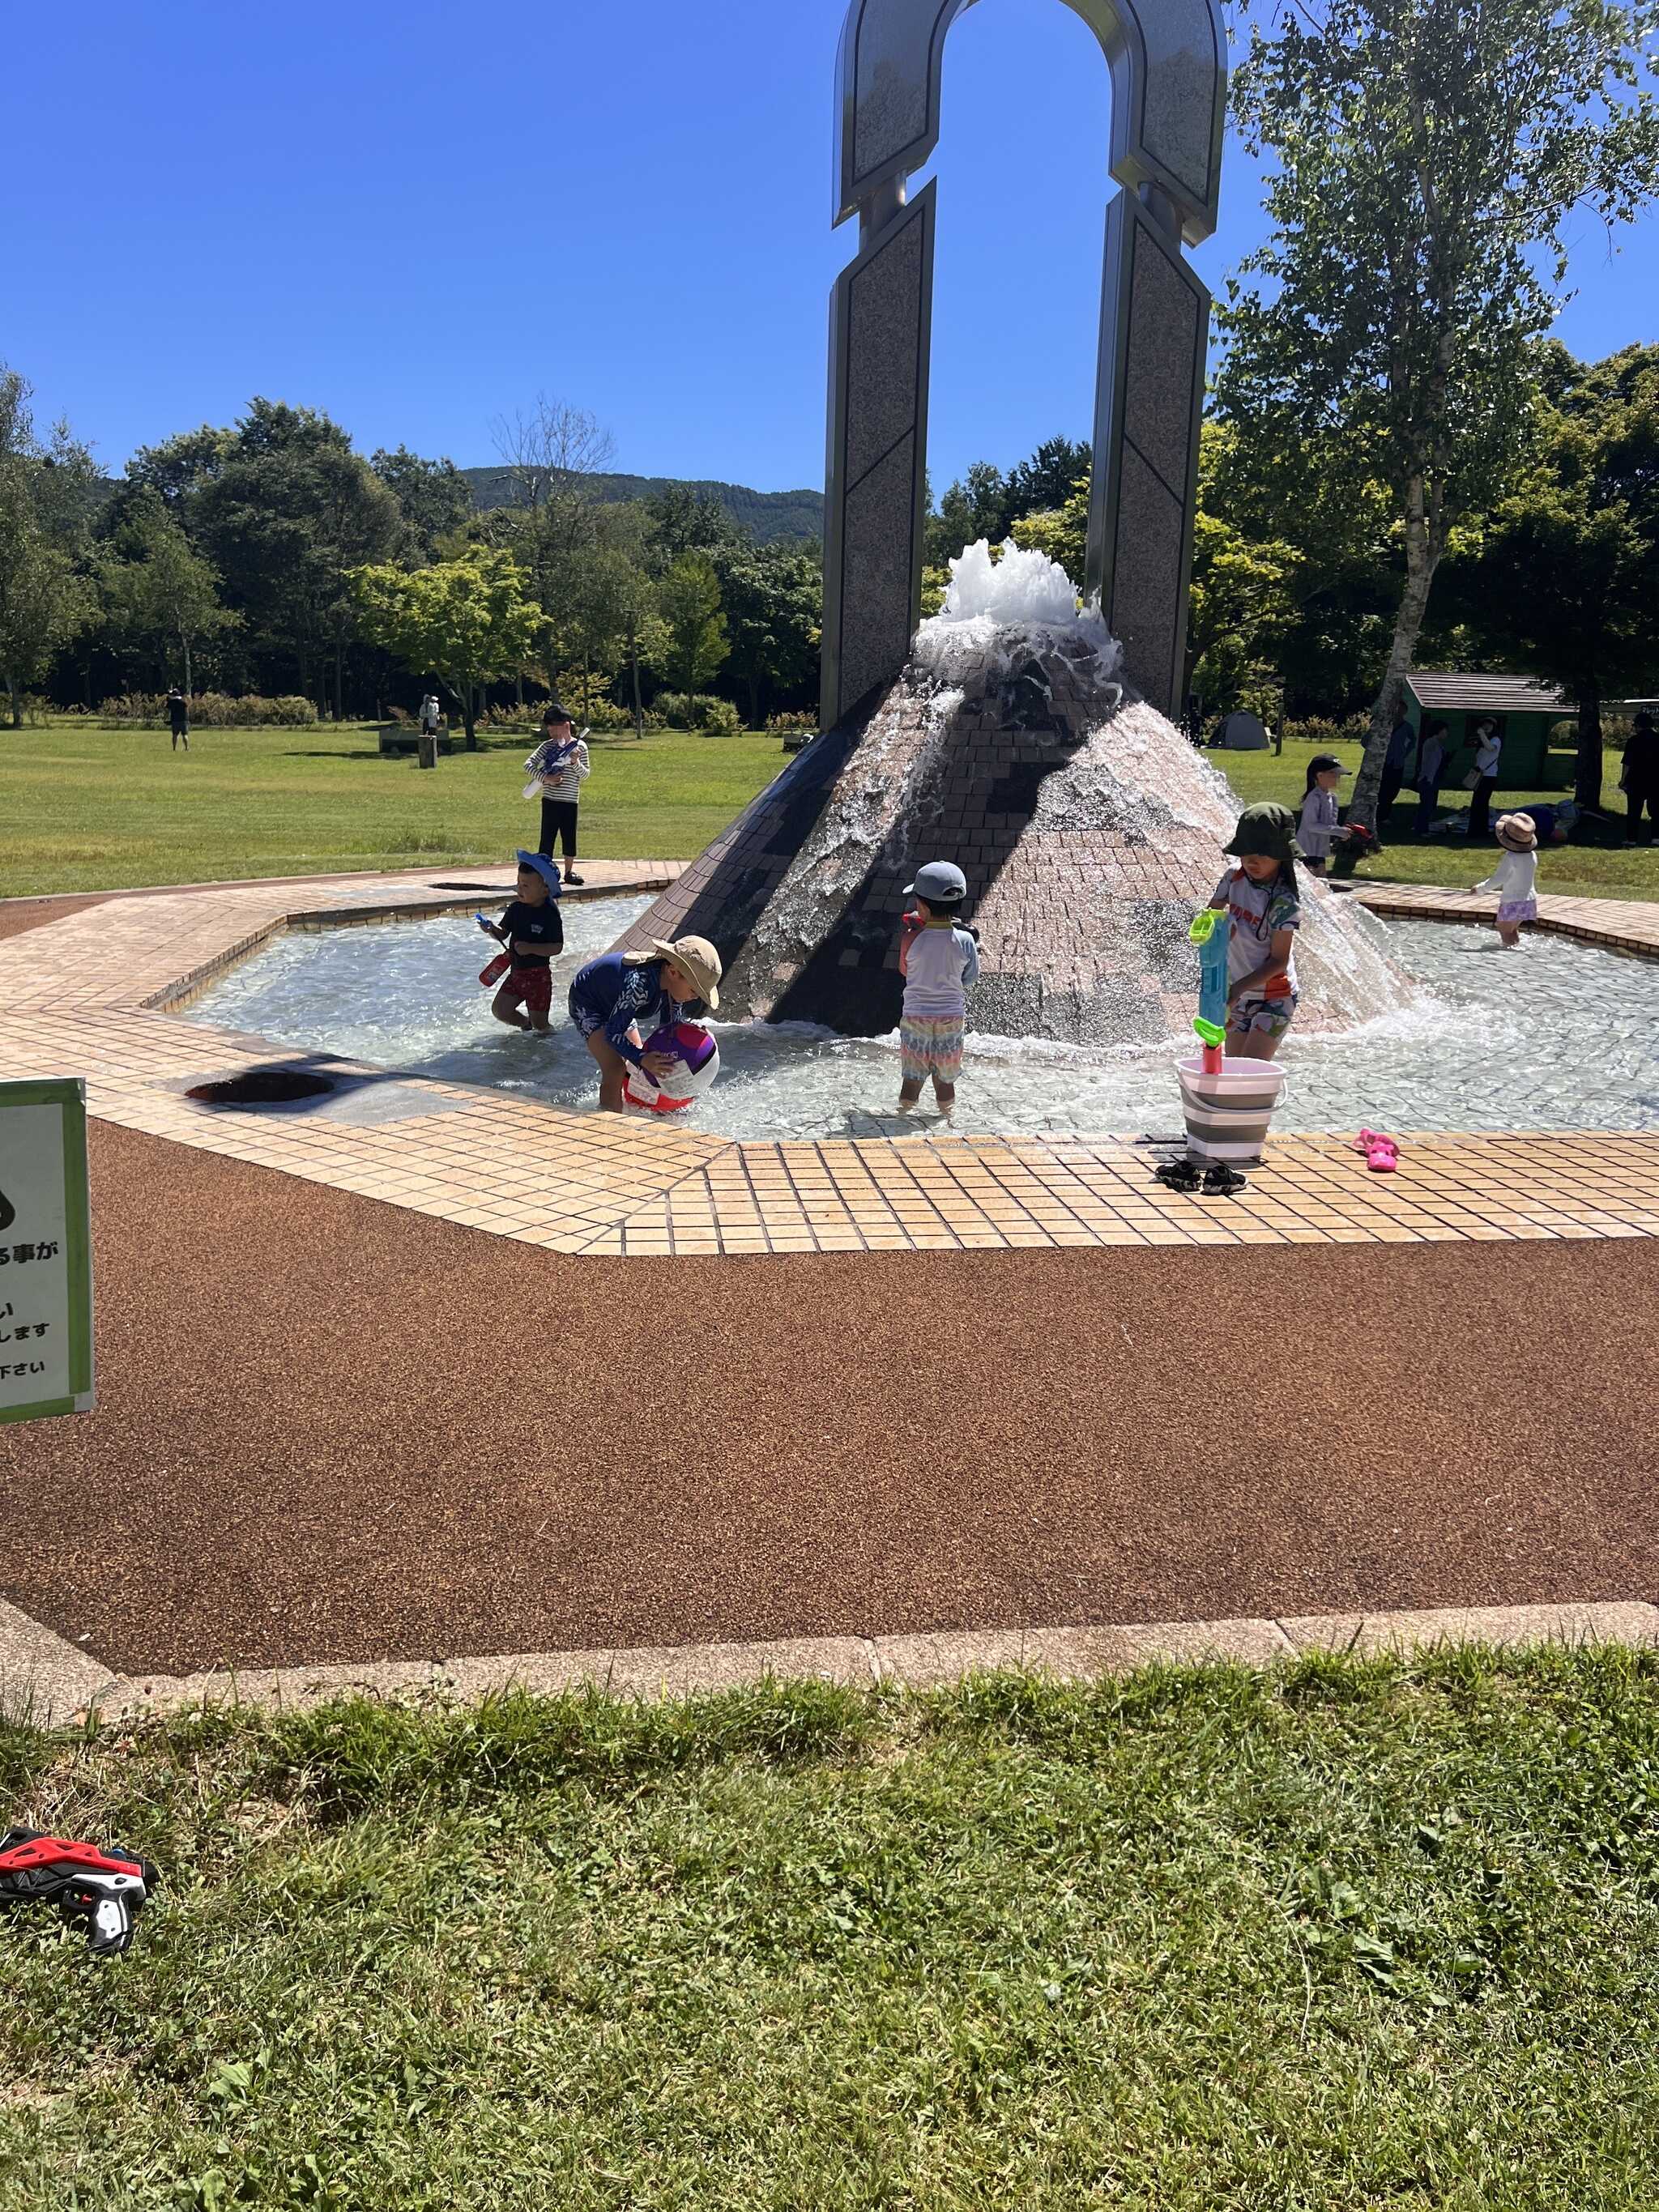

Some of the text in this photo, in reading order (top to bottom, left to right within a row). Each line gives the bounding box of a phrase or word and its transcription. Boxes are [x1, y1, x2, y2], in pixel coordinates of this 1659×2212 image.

[0, 1241, 58, 1265] る事が
[0, 1323, 50, 1342] します
